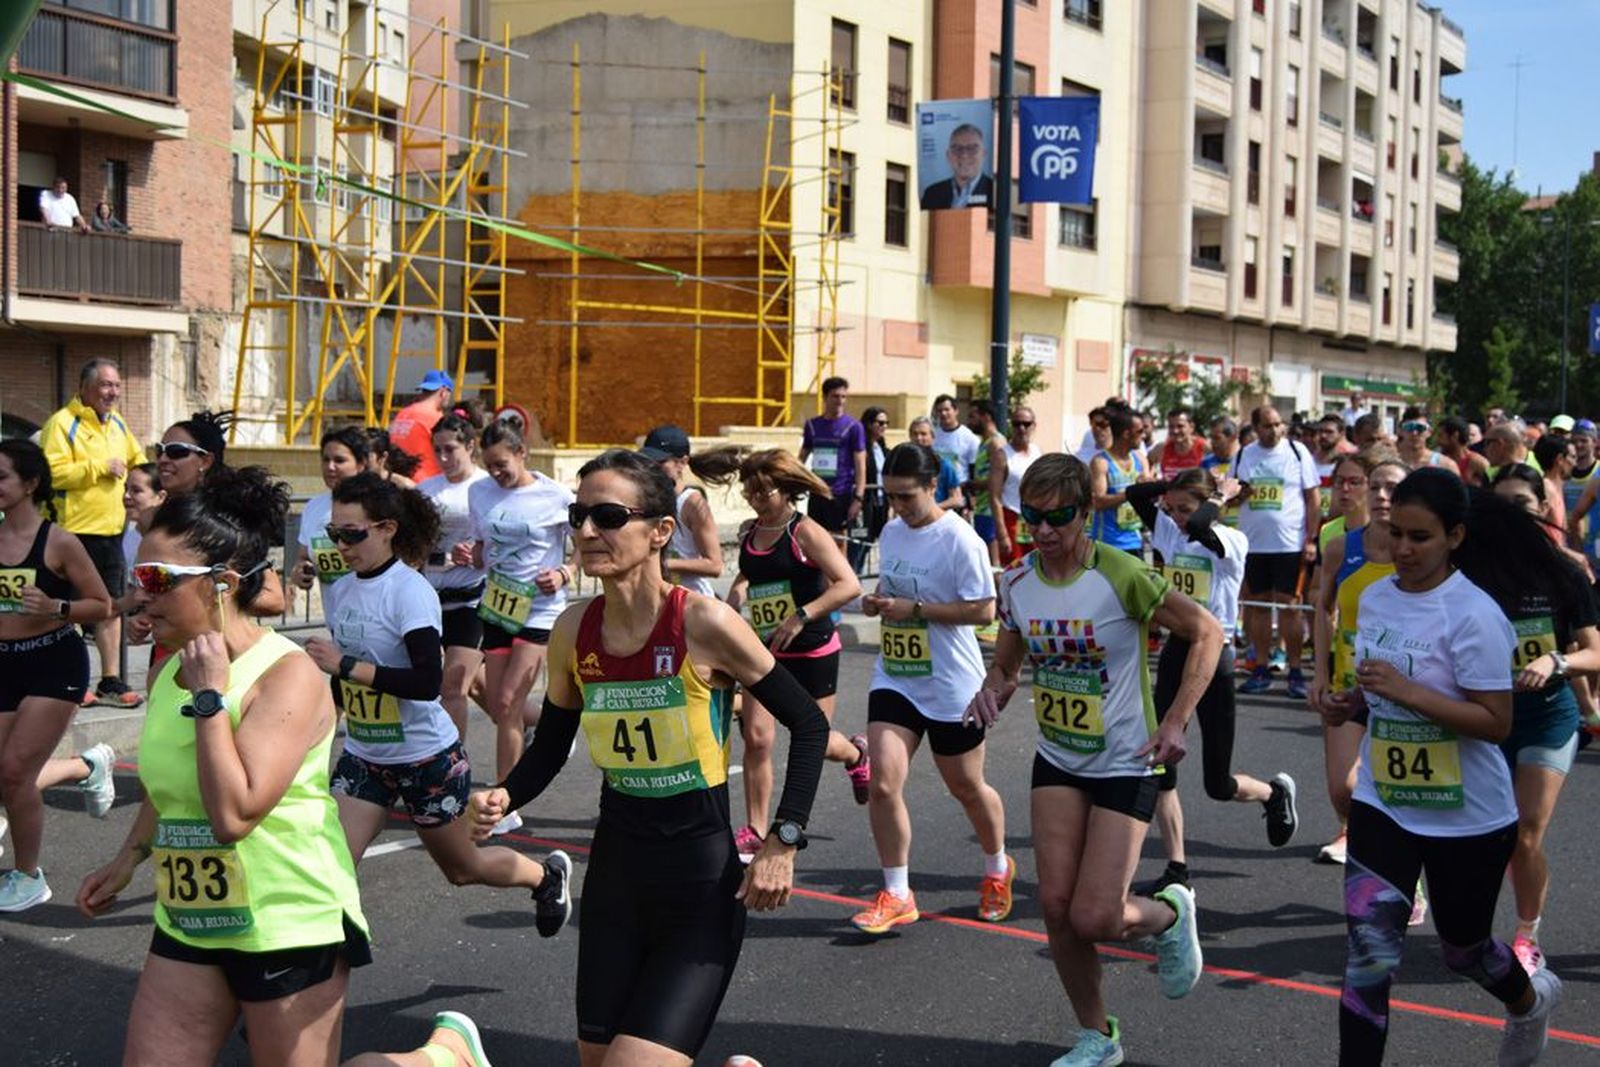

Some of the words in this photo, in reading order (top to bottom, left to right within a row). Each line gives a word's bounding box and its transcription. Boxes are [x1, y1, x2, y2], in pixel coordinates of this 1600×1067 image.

[1032, 125, 1081, 141] VOTA
[318, 553, 350, 571] 65
[493, 588, 518, 616] 111
[752, 600, 788, 626] 662
[14, 634, 54, 653] NIKE
[883, 632, 922, 659] 656
[345, 687, 383, 719] 217
[632, 697, 669, 709] RURAL
[1040, 692, 1090, 730] 212
[613, 717, 658, 762] 41
[1387, 746, 1434, 781] 84
[650, 770, 696, 788] RURAL
[1420, 791, 1458, 801] RURAL
[162, 854, 228, 901] 133
[206, 915, 250, 927] RURAL
